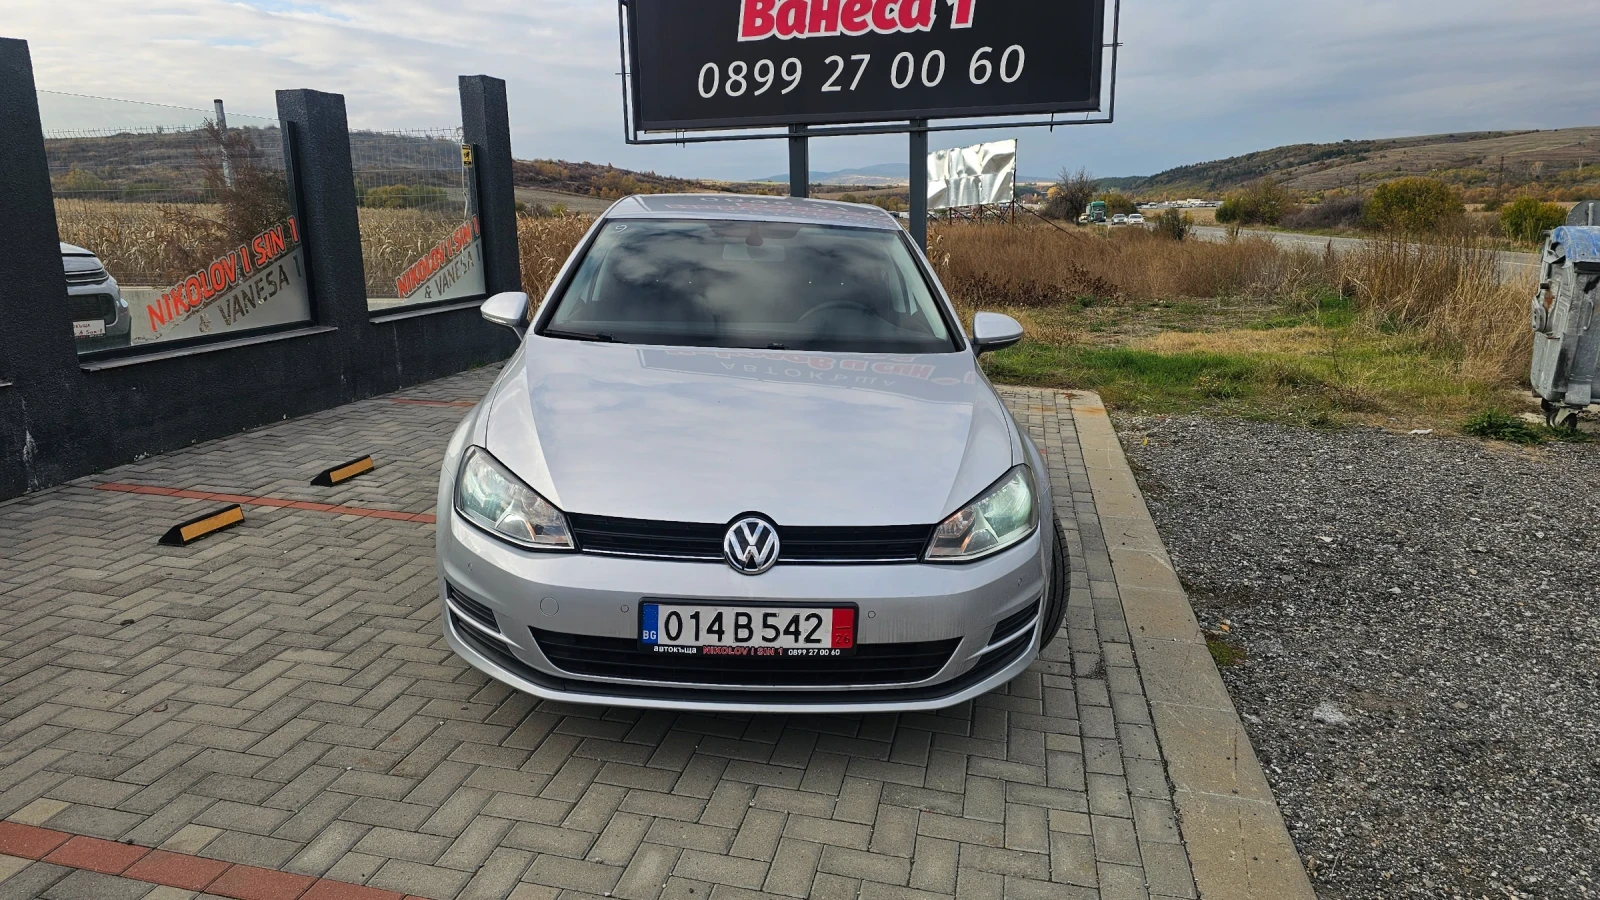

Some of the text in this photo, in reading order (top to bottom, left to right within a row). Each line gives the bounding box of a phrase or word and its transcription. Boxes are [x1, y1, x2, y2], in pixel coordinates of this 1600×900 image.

[739, 0, 936, 40] Ванеса
[698, 44, 1025, 98] 0899 27 00 60
[146, 216, 300, 332] NIKOLOV I SIN 1
[395, 239, 446, 298] NIKOLOV
[453, 220, 472, 253] SIN
[472, 214, 480, 236] 1
[424, 285, 432, 298] &
[434, 251, 475, 296] VANESA
[199, 254, 302, 333] & VANESA 1
[642, 610, 823, 644] BG 014B542
[653, 645, 697, 654] автокъща
[703, 646, 748, 655] NIKOLOV
[757, 648, 774, 656] SIN
[778, 648, 783, 656] 1
